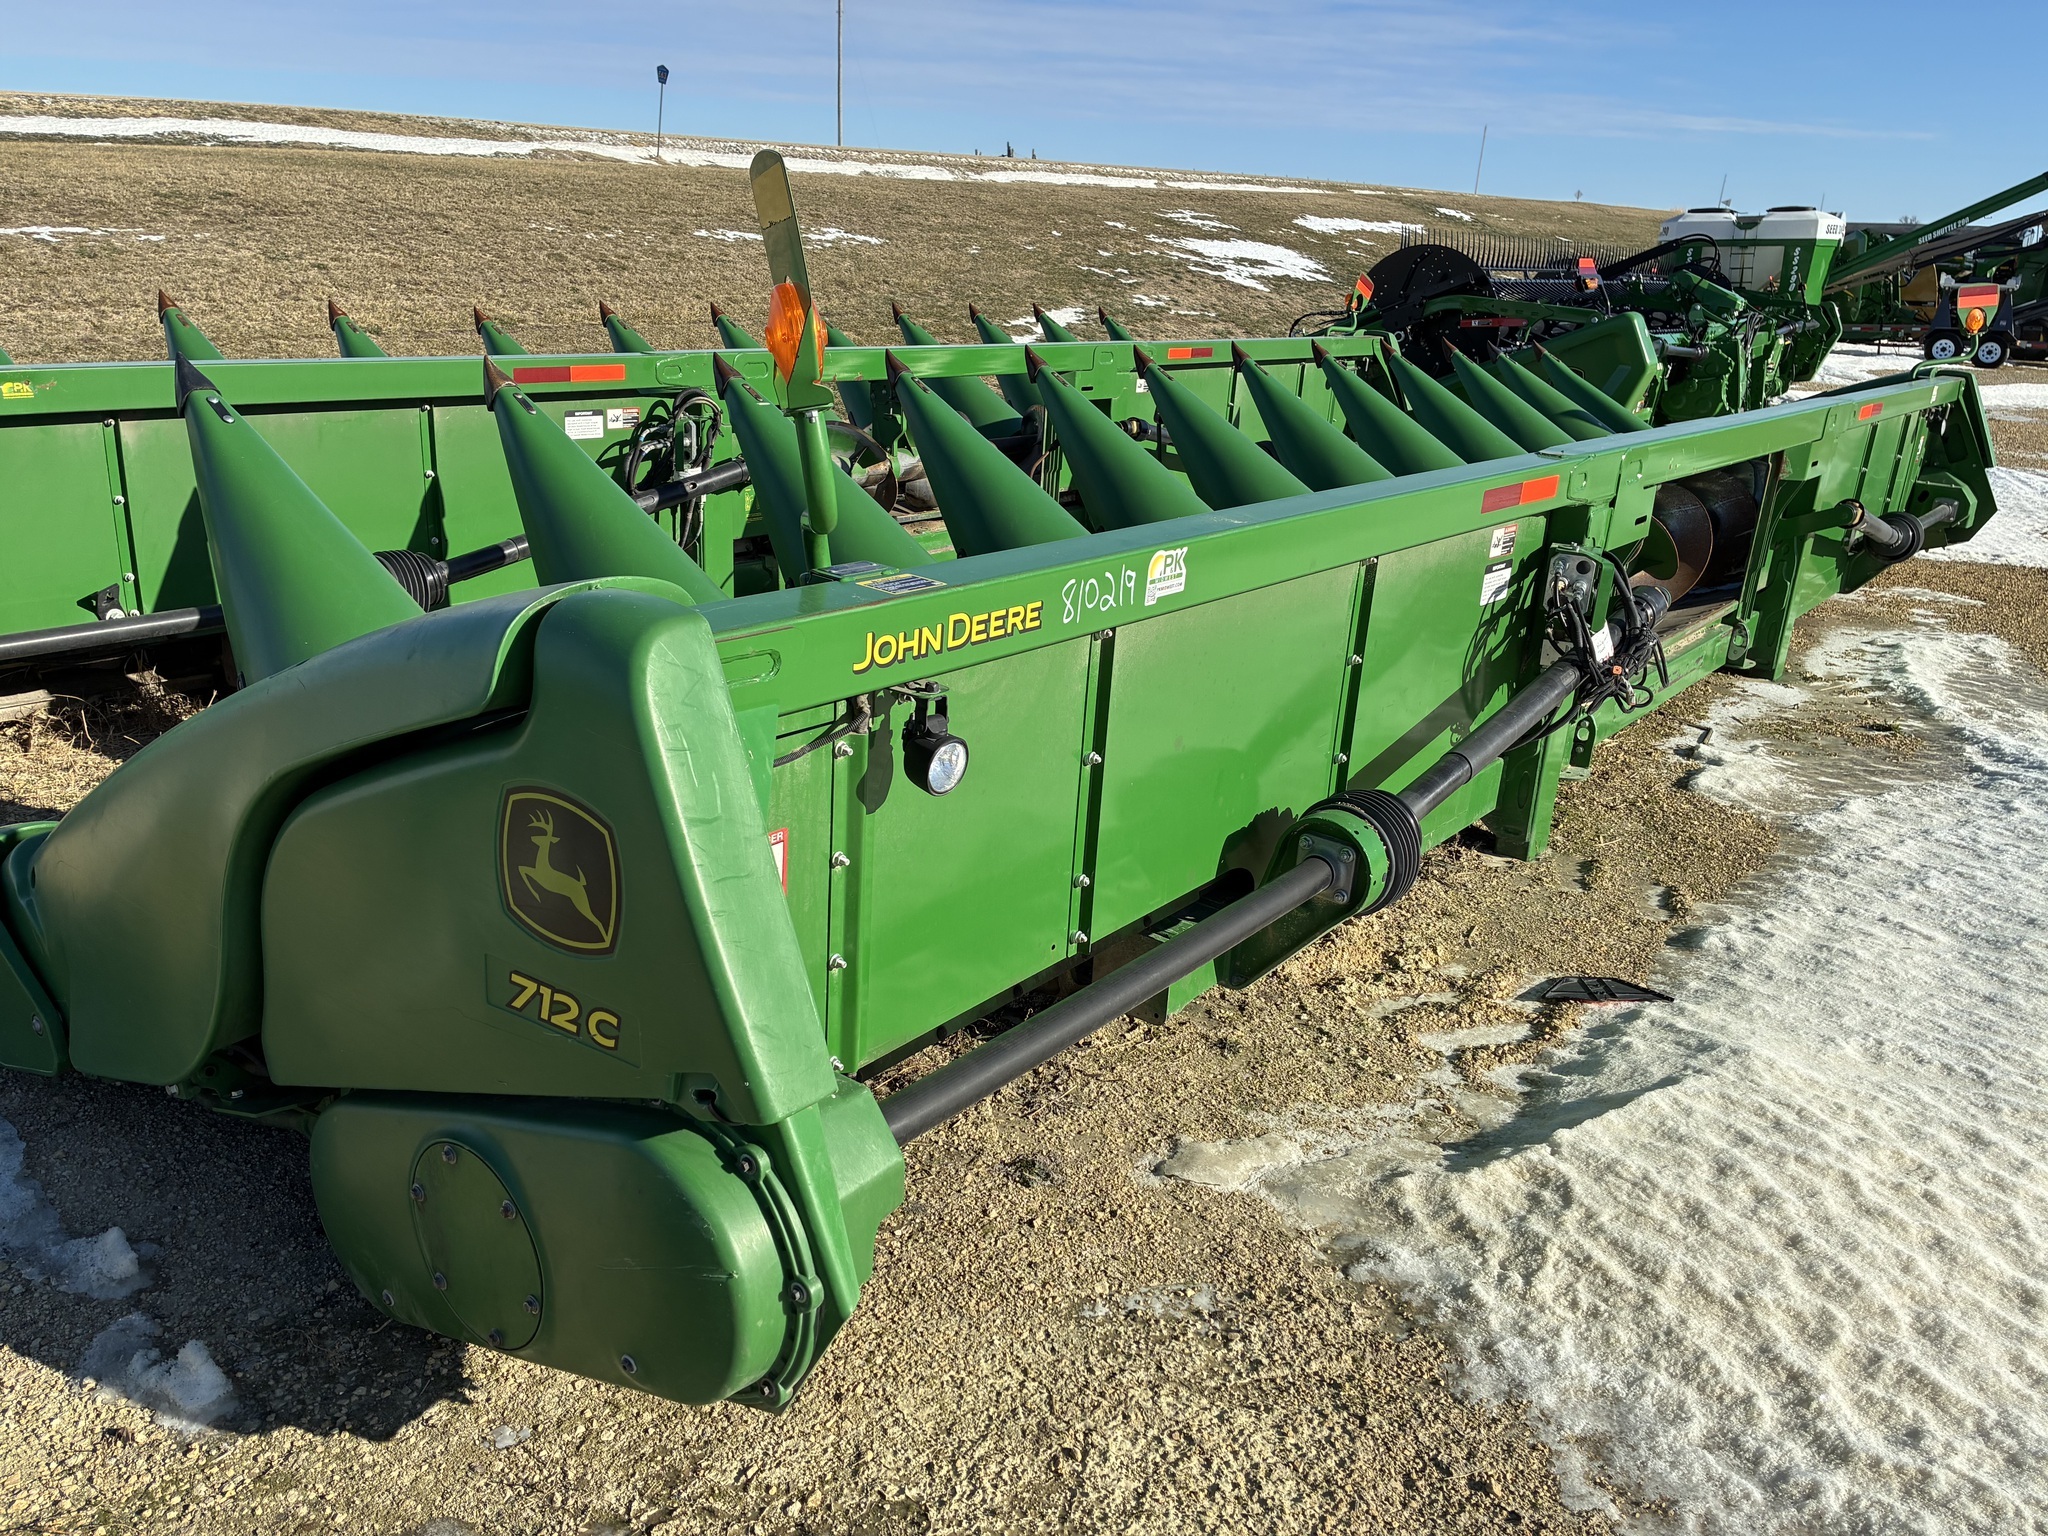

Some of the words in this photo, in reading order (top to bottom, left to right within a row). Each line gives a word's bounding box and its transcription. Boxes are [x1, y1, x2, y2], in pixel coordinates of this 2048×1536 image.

[1918, 233, 1933, 245] SEED
[1933, 221, 1957, 239] SHUTTLE
[1788, 246, 1801, 292] SS290
[852, 623, 943, 673] JOHN
[947, 600, 1044, 653] DEERE
